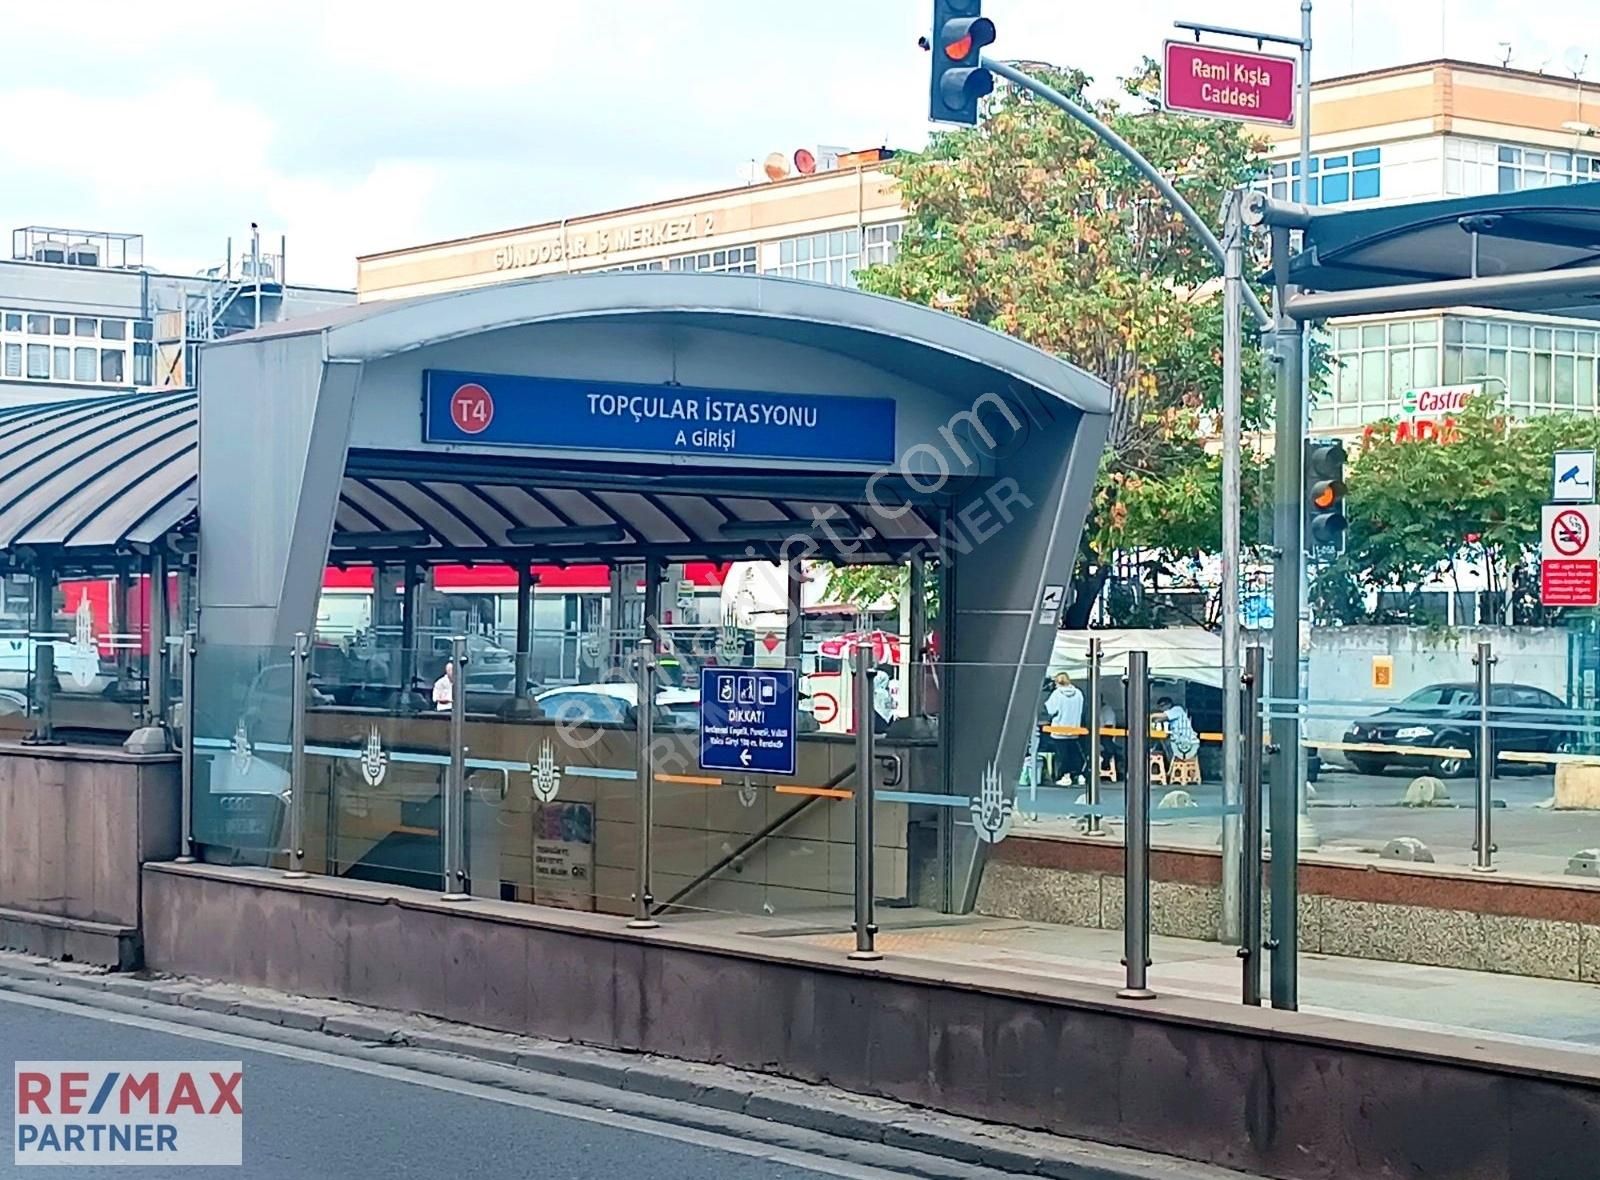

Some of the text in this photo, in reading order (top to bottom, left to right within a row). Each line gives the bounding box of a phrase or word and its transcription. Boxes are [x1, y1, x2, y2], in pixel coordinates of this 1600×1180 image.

[1191, 58, 1271, 88] Rami Kışla
[1201, 83, 1261, 109] Caddesi
[457, 398, 488, 423] T4
[587, 393, 818, 428] TOPÇULAR İSTASYONU
[1419, 388, 1474, 412] Castro
[674, 427, 736, 451] A GİRİŞİ
